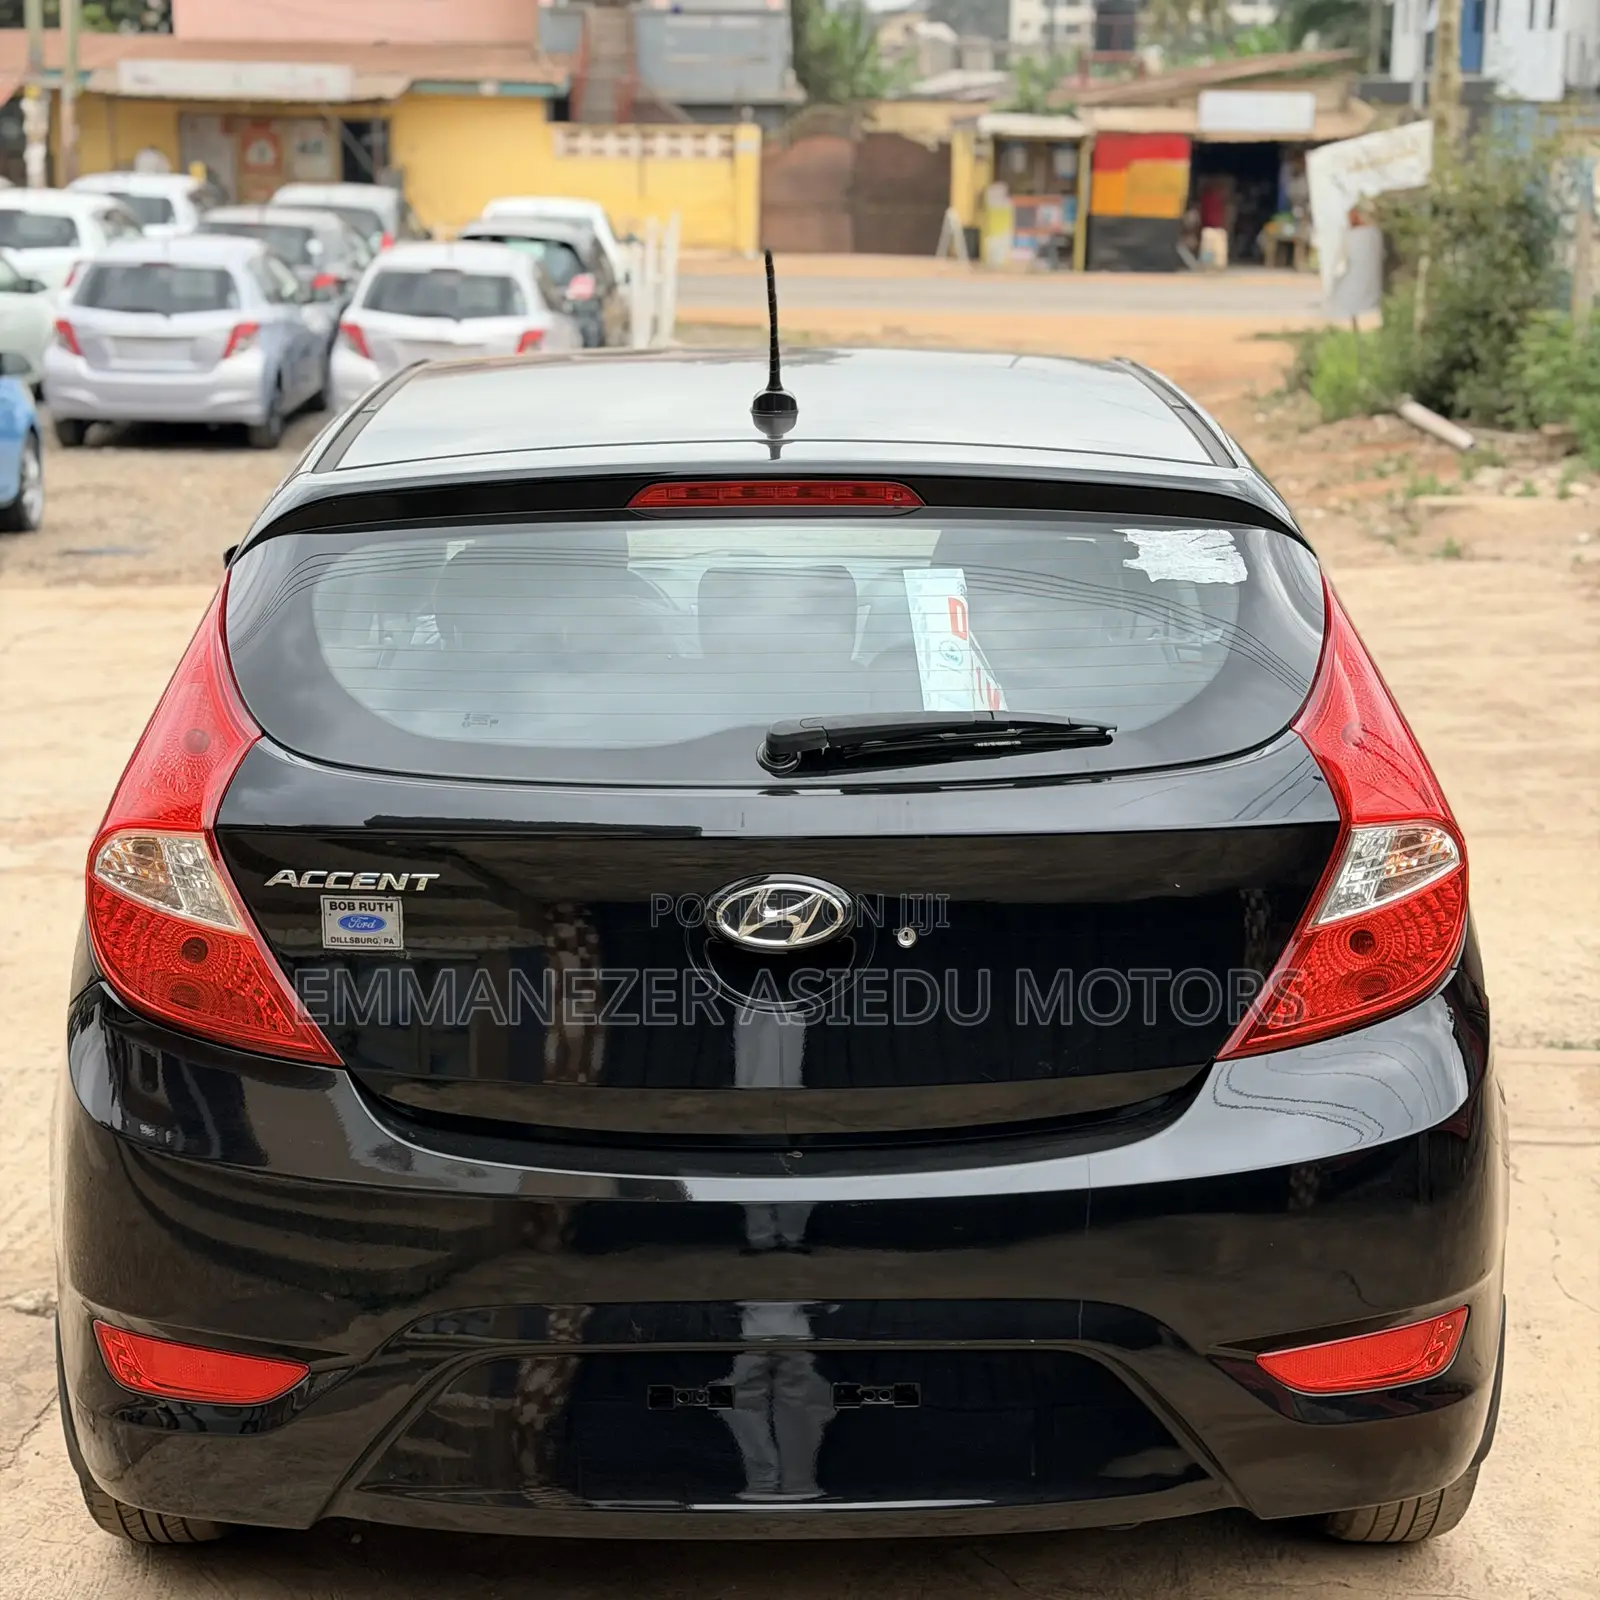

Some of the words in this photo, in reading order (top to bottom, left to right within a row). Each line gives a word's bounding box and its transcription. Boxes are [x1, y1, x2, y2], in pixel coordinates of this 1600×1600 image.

[264, 869, 441, 892] ACCENT
[329, 901, 356, 911] BOB
[359, 902, 394, 912] RUTH
[347, 916, 376, 929] Ford
